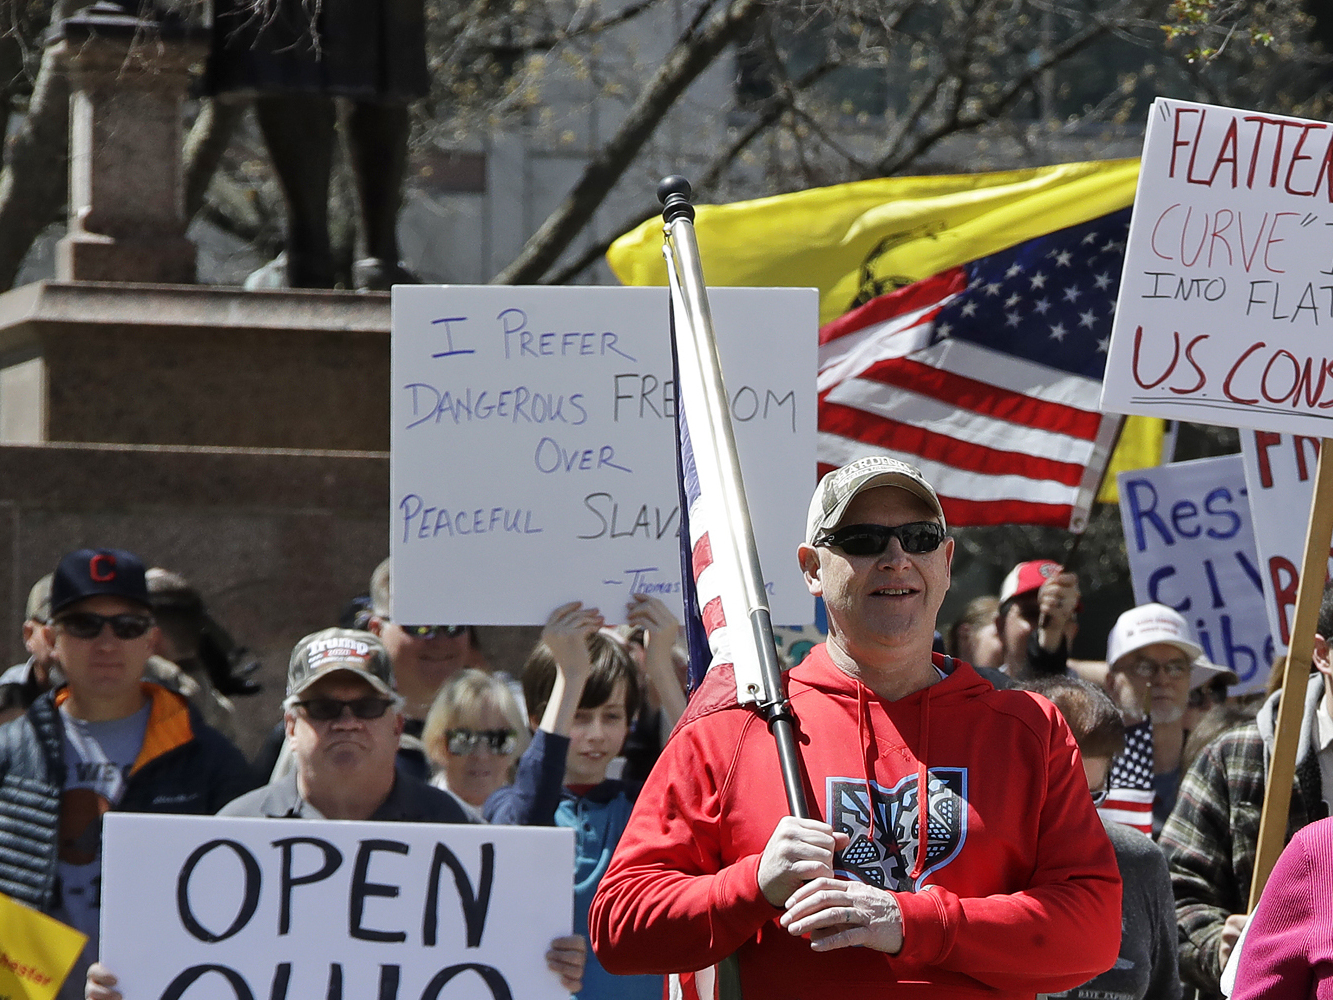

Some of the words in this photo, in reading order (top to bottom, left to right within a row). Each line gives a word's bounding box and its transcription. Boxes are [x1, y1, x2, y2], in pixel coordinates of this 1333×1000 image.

[1142, 271, 1226, 301] INTO
[431, 317, 475, 358] I
[404, 383, 589, 430] DANGEROUS
[614, 373, 796, 433] FREOM
[577, 492, 682, 540] SLAV
[1126, 479, 1249, 552] Res
[89, 554, 117, 582] C
[306, 637, 369, 656] Trump
[176, 837, 495, 948] OPEN
